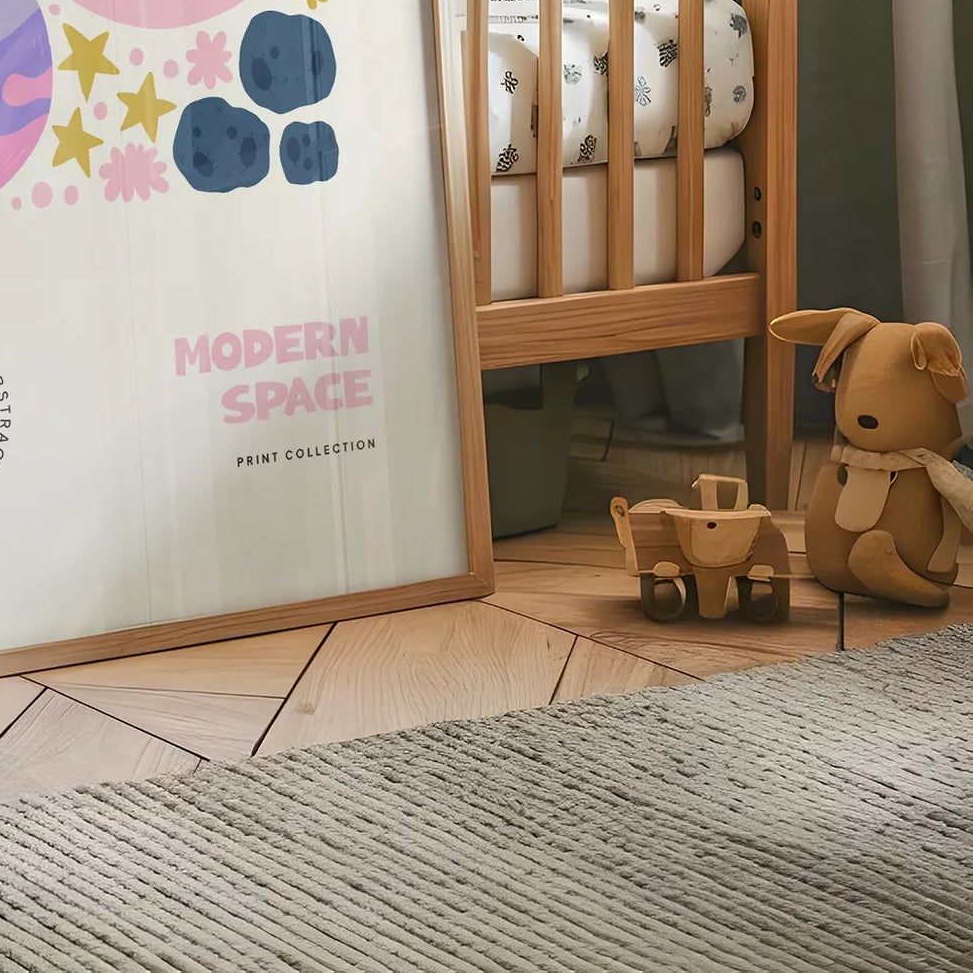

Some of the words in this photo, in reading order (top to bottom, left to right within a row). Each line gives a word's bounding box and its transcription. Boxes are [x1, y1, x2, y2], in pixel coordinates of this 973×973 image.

[174, 315, 369, 376] MODERN
[221, 369, 373, 424] SPACE
[237, 451, 278, 467] PRINT
[285, 438, 376, 460] COLLECTION
